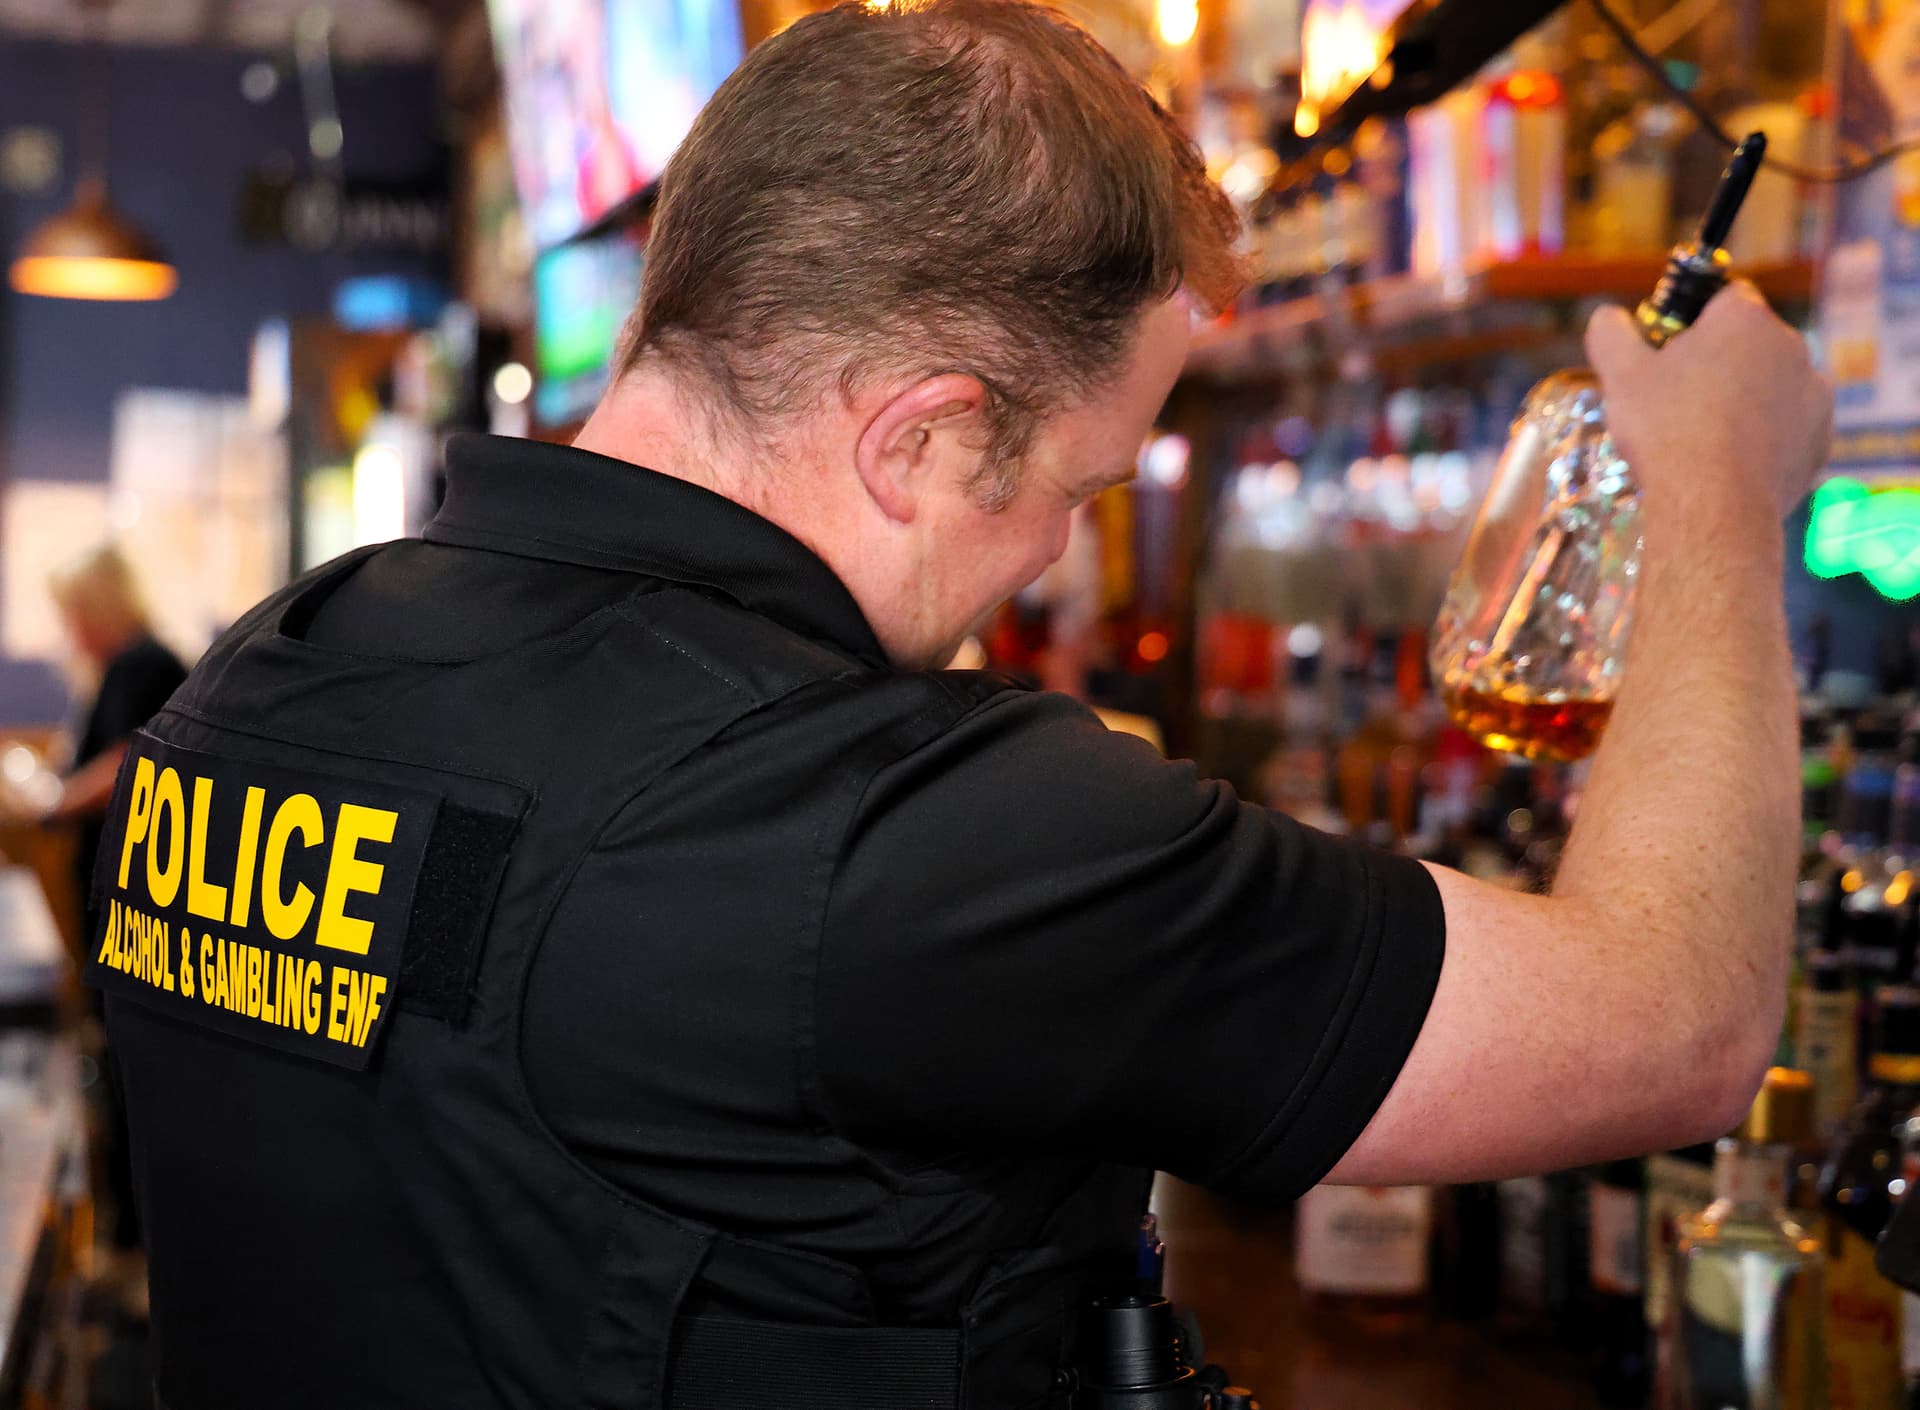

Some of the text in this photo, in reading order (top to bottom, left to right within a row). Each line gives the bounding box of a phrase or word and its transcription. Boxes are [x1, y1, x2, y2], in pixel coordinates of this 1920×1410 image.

[118, 756, 399, 956] POLICE
[98, 898, 388, 1048] ALCOHOL & GAMBLING ENF
